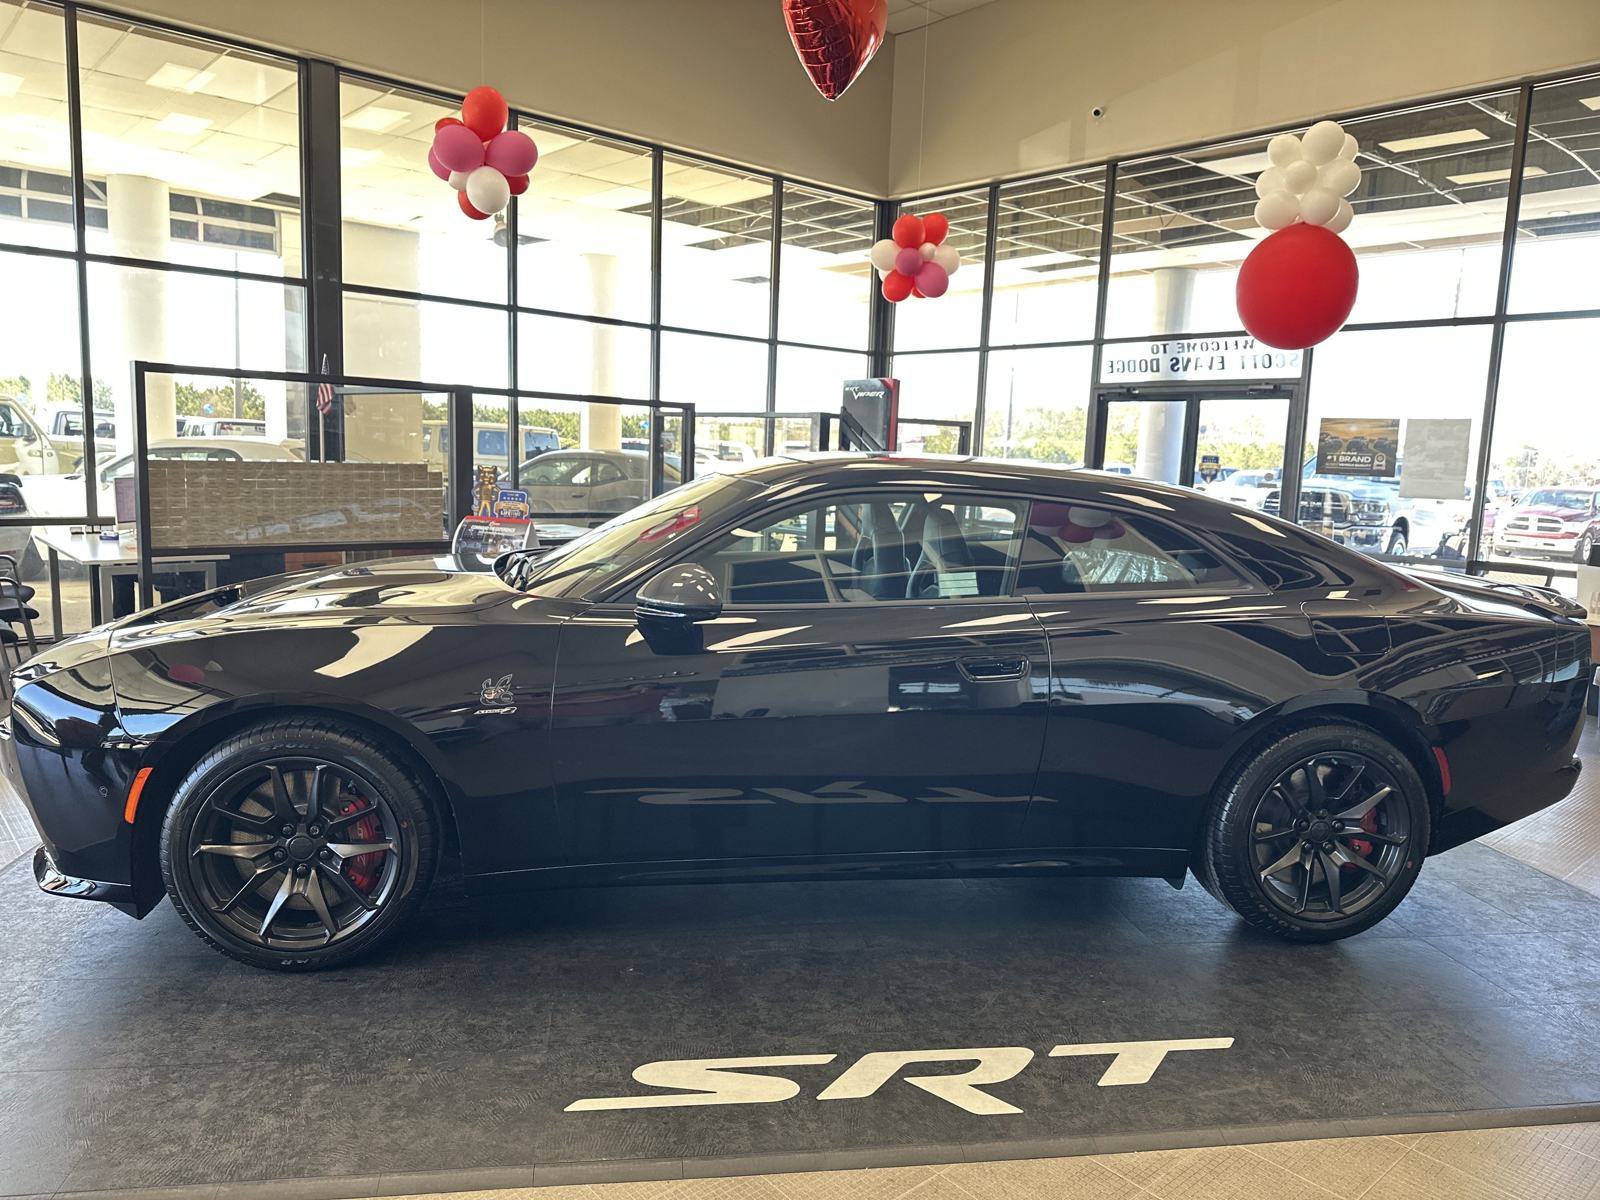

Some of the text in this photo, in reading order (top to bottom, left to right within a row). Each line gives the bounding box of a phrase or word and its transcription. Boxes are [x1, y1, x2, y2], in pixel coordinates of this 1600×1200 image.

[851, 388, 885, 400] VIPER
[1339, 455, 1372, 463] BRAND
[564, 1037, 1235, 1115] SRT
